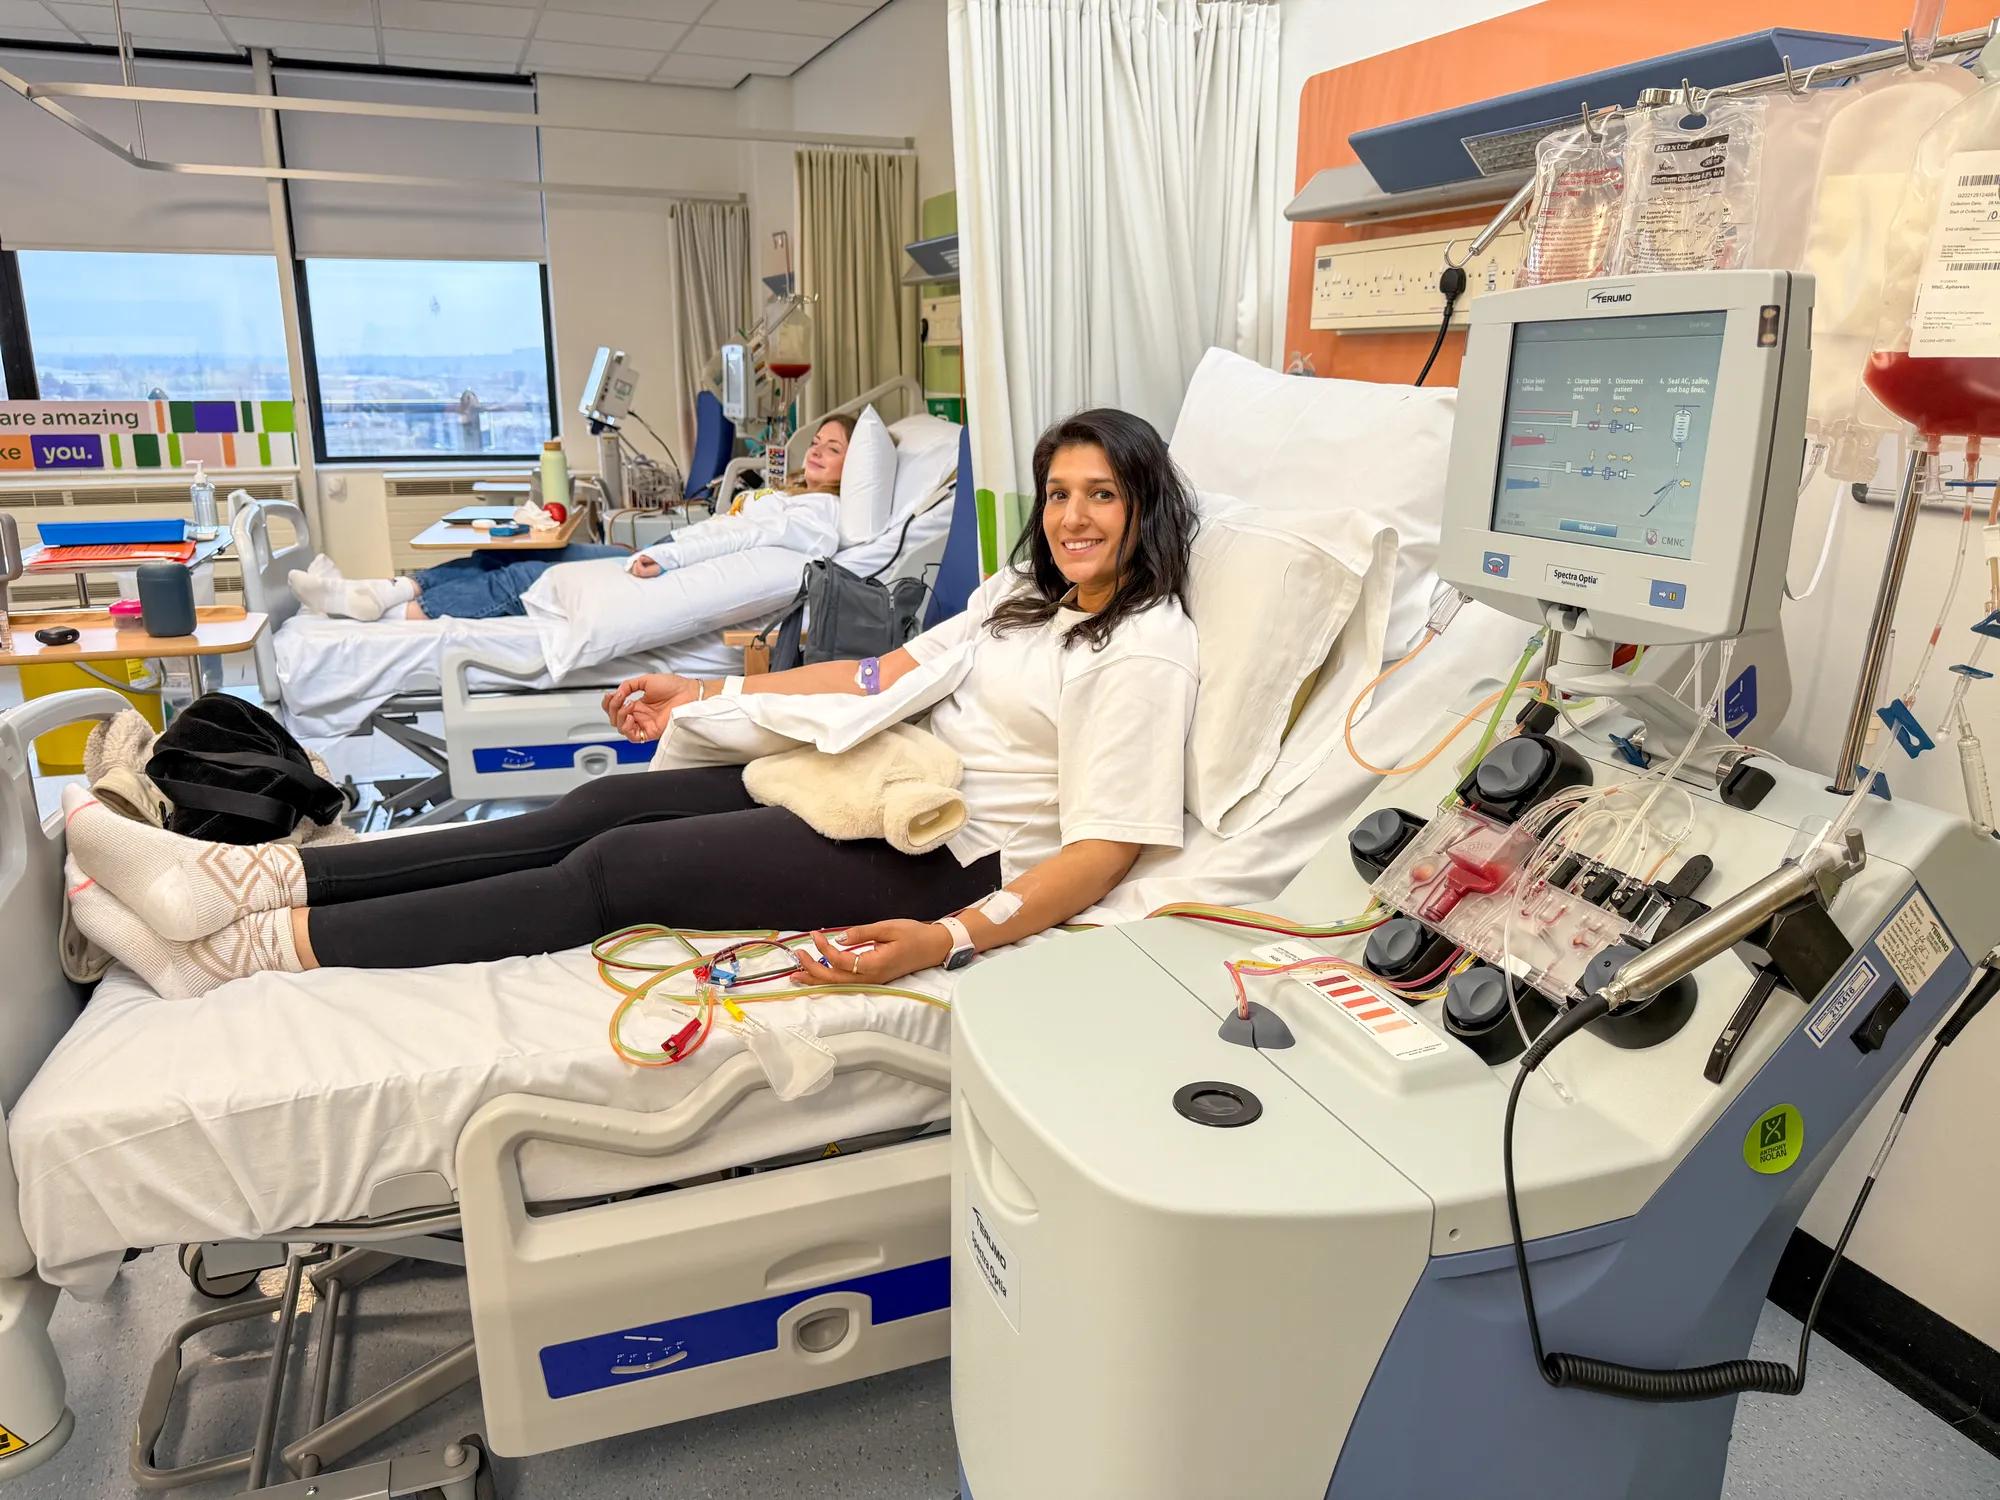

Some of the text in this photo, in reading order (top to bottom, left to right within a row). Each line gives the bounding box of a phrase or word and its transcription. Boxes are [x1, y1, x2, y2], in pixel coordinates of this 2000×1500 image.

[1656, 143, 1691, 153] Baxter
[1652, 175, 1677, 184] Sodium
[1678, 173, 1701, 182] Chloride
[1591, 291, 1632, 304] TERUMO
[1680, 377, 1690, 385] AC,
[1691, 376, 1710, 385] saline,
[1678, 386, 1689, 394] bag
[0, 409, 139, 429] are amazing
[42, 446, 93, 464] you.
[1661, 536, 1685, 547] CMNC
[1554, 569, 1577, 580] Spectra
[1930, 920, 1949, 952] TERUMO
[1829, 986, 1855, 1018] 213416
[1760, 1144, 1786, 1156] ANTHONY
[1760, 1150, 1786, 1163] NOLAN
[972, 1206, 1006, 1270] TERUMO
[990, 1265, 1006, 1298] Optia
